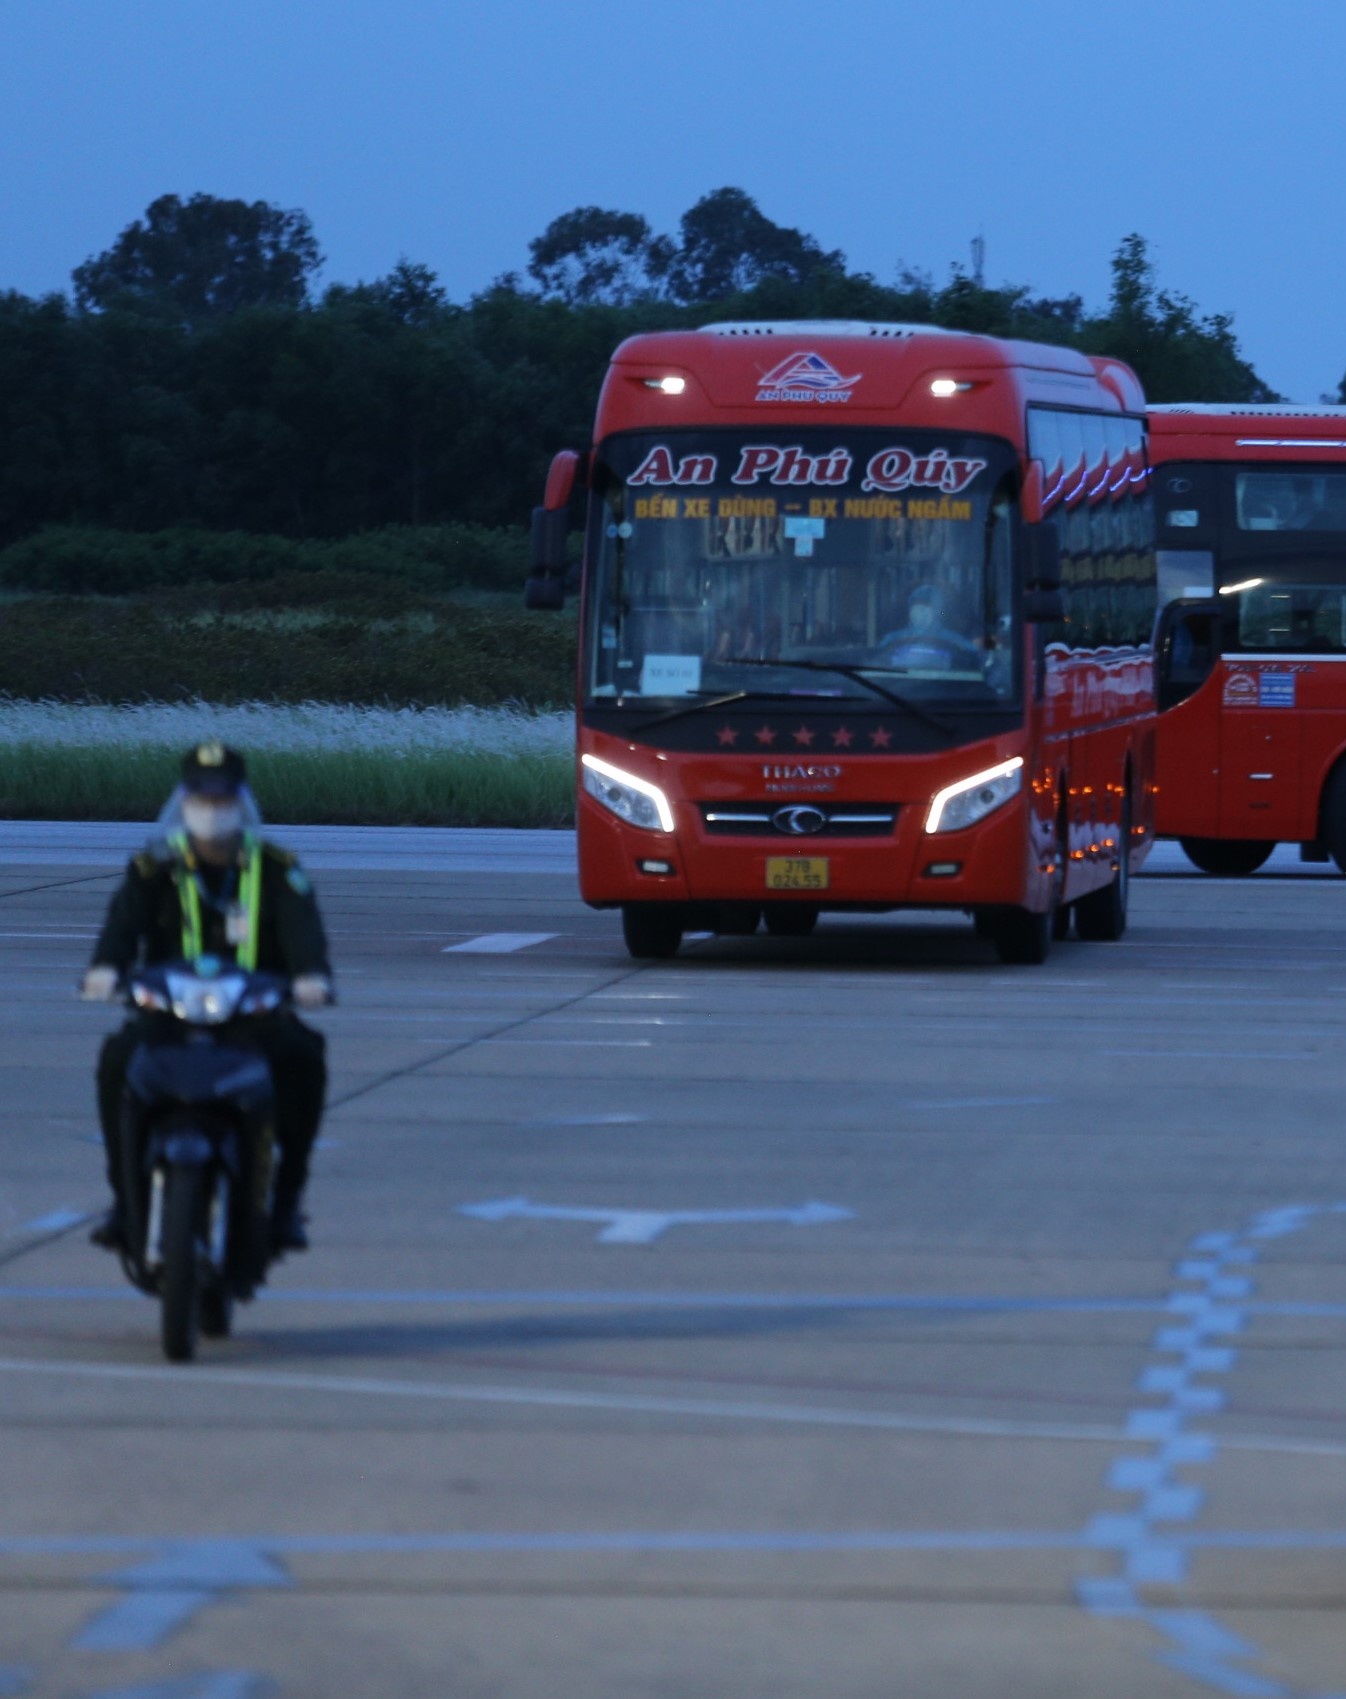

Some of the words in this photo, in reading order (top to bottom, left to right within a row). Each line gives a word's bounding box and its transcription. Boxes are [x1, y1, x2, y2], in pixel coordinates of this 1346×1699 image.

[626, 446, 716, 485] An
[731, 446, 852, 485] Phú
[684, 498, 711, 518] XE
[809, 498, 837, 518] BX
